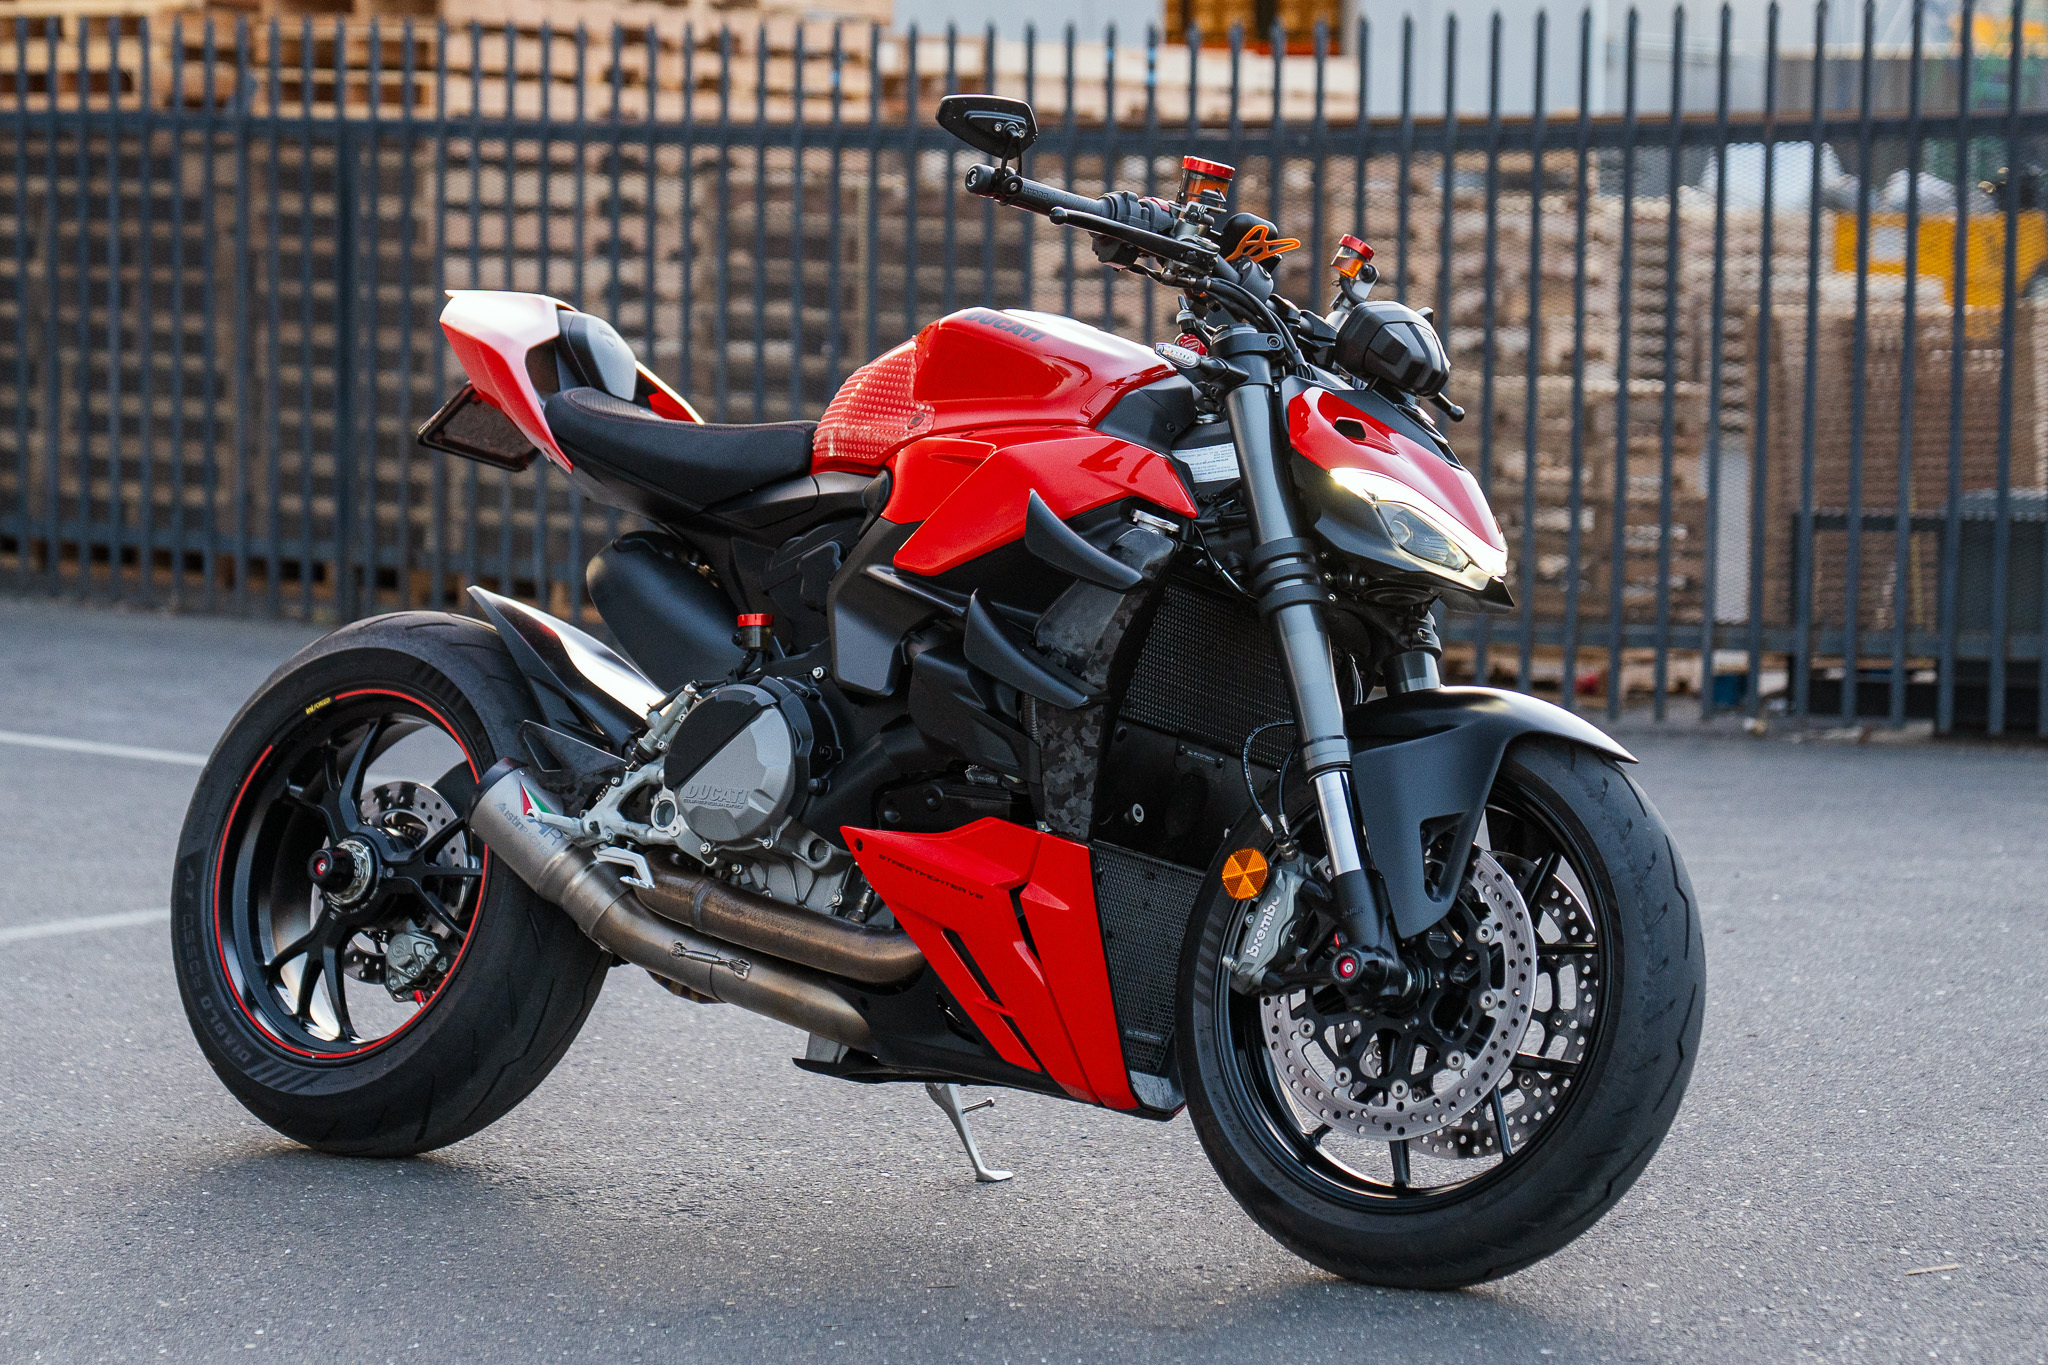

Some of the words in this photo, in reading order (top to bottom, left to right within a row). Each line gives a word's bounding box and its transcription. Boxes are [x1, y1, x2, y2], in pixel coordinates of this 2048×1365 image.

[963, 311, 1045, 343] DUCATI
[685, 784, 749, 805] DUCATI
[878, 853, 967, 894] STREETFIGHTER
[968, 889, 984, 900] V2
[199, 994, 252, 1064] DIABLO
